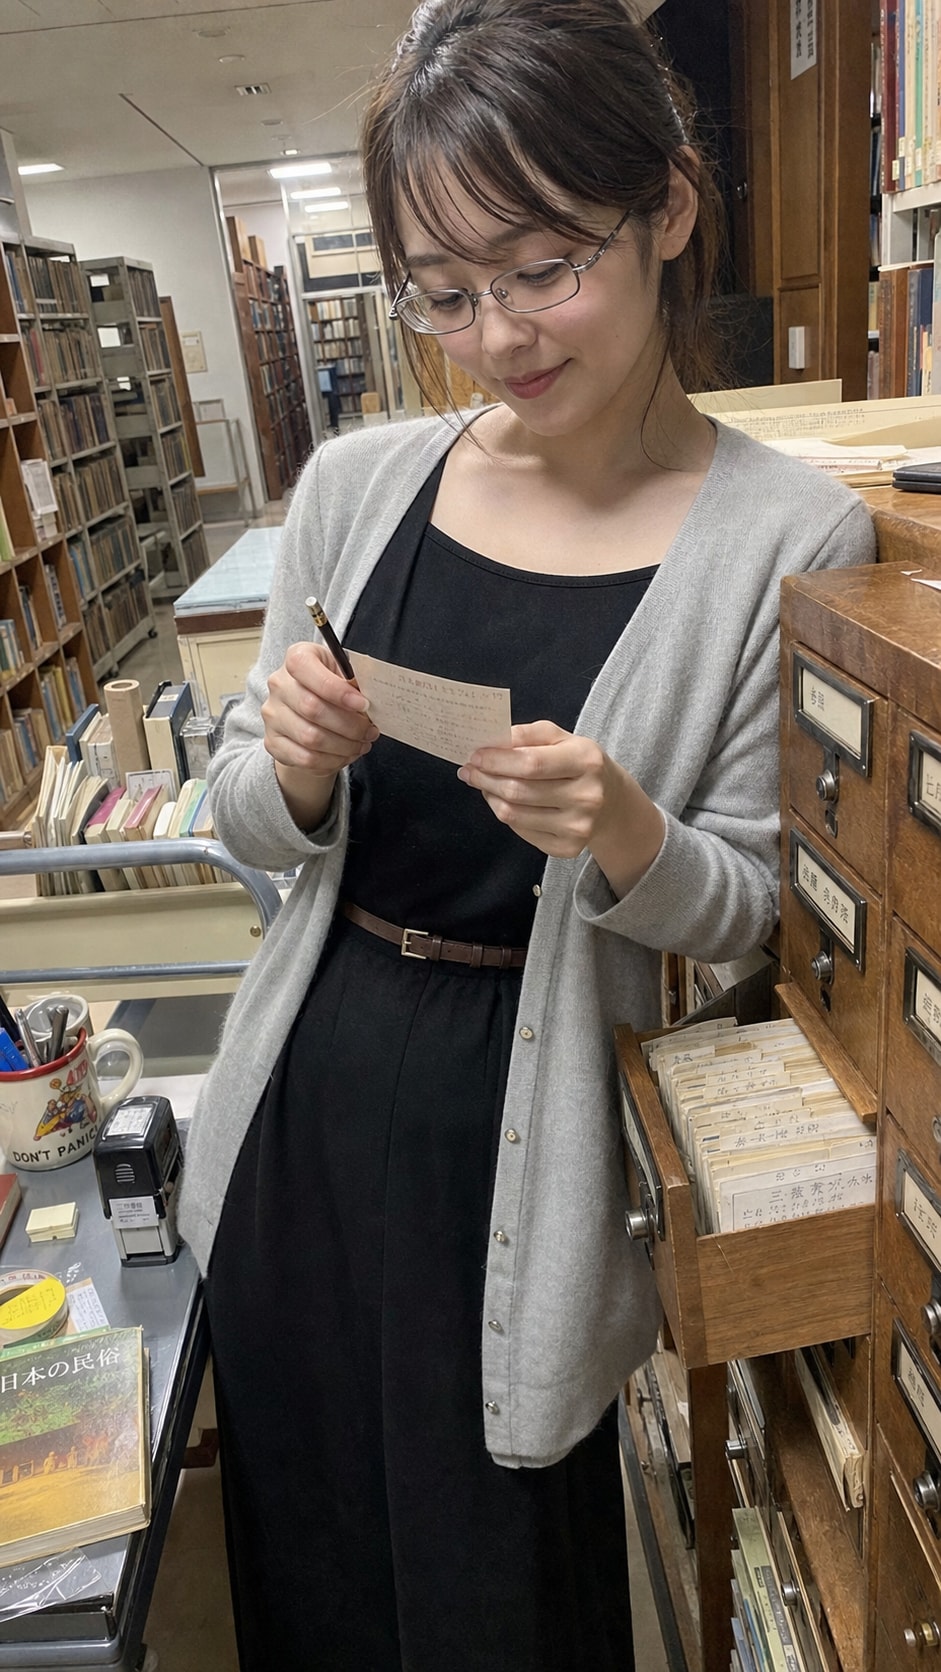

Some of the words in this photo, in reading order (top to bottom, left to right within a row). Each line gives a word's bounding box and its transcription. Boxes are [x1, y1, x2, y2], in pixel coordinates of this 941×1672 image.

[13, 1150, 51, 1163] DON'T
[1, 1347, 121, 1393] 日本の民俗
